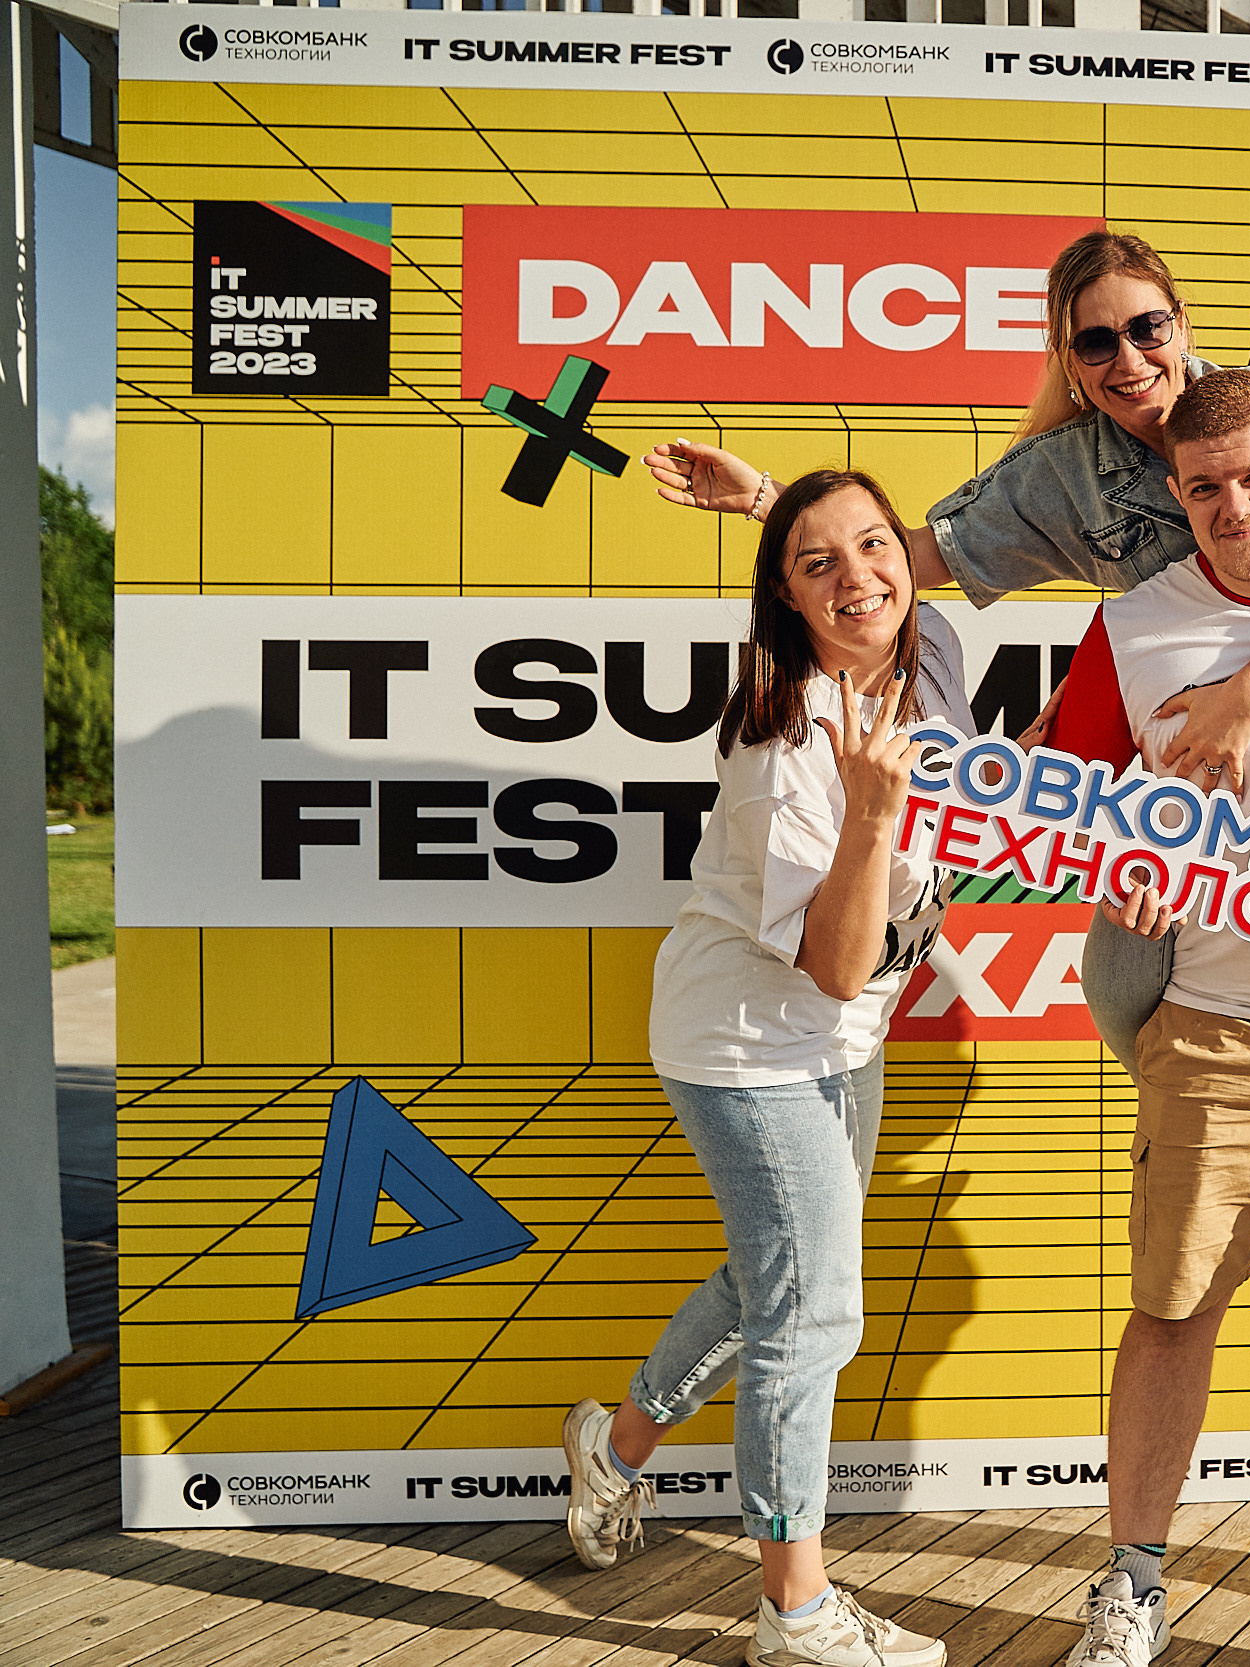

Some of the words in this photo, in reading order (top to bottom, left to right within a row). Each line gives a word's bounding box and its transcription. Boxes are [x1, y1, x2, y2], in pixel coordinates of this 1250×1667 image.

[225, 29, 368, 47] СОВКОМБАНК
[225, 48, 331, 61] ТЕХНОЛОГИИ
[404, 38, 438, 60] IT
[449, 39, 620, 64] SUMMER
[630, 44, 731, 67] FEST
[811, 43, 950, 60] СОВКОМБАНК
[811, 60, 914, 74] ТЕХНОЛОГИИ
[985, 52, 1020, 74] IT
[1028, 53, 1194, 81] SUMMER
[210, 294, 378, 321] SUMMER
[518, 258, 1048, 352] DANCE
[210, 323, 310, 348] FEST
[209, 351, 317, 376] 2023
[261, 640, 429, 739] IT
[261, 778, 721, 884] FEST
[227, 1474, 371, 1492] СОВКОМБАНК
[828, 1462, 948, 1479] ОВКОМБАНК
[983, 1465, 1018, 1487] IT
[1026, 1462, 1109, 1486] SUM
[228, 1492, 334, 1506] ТЕХНОЛОГИИ
[406, 1477, 443, 1500] IT
[451, 1474, 571, 1499] SUMM
[829, 1480, 913, 1494] ХНОЛОГИИ
